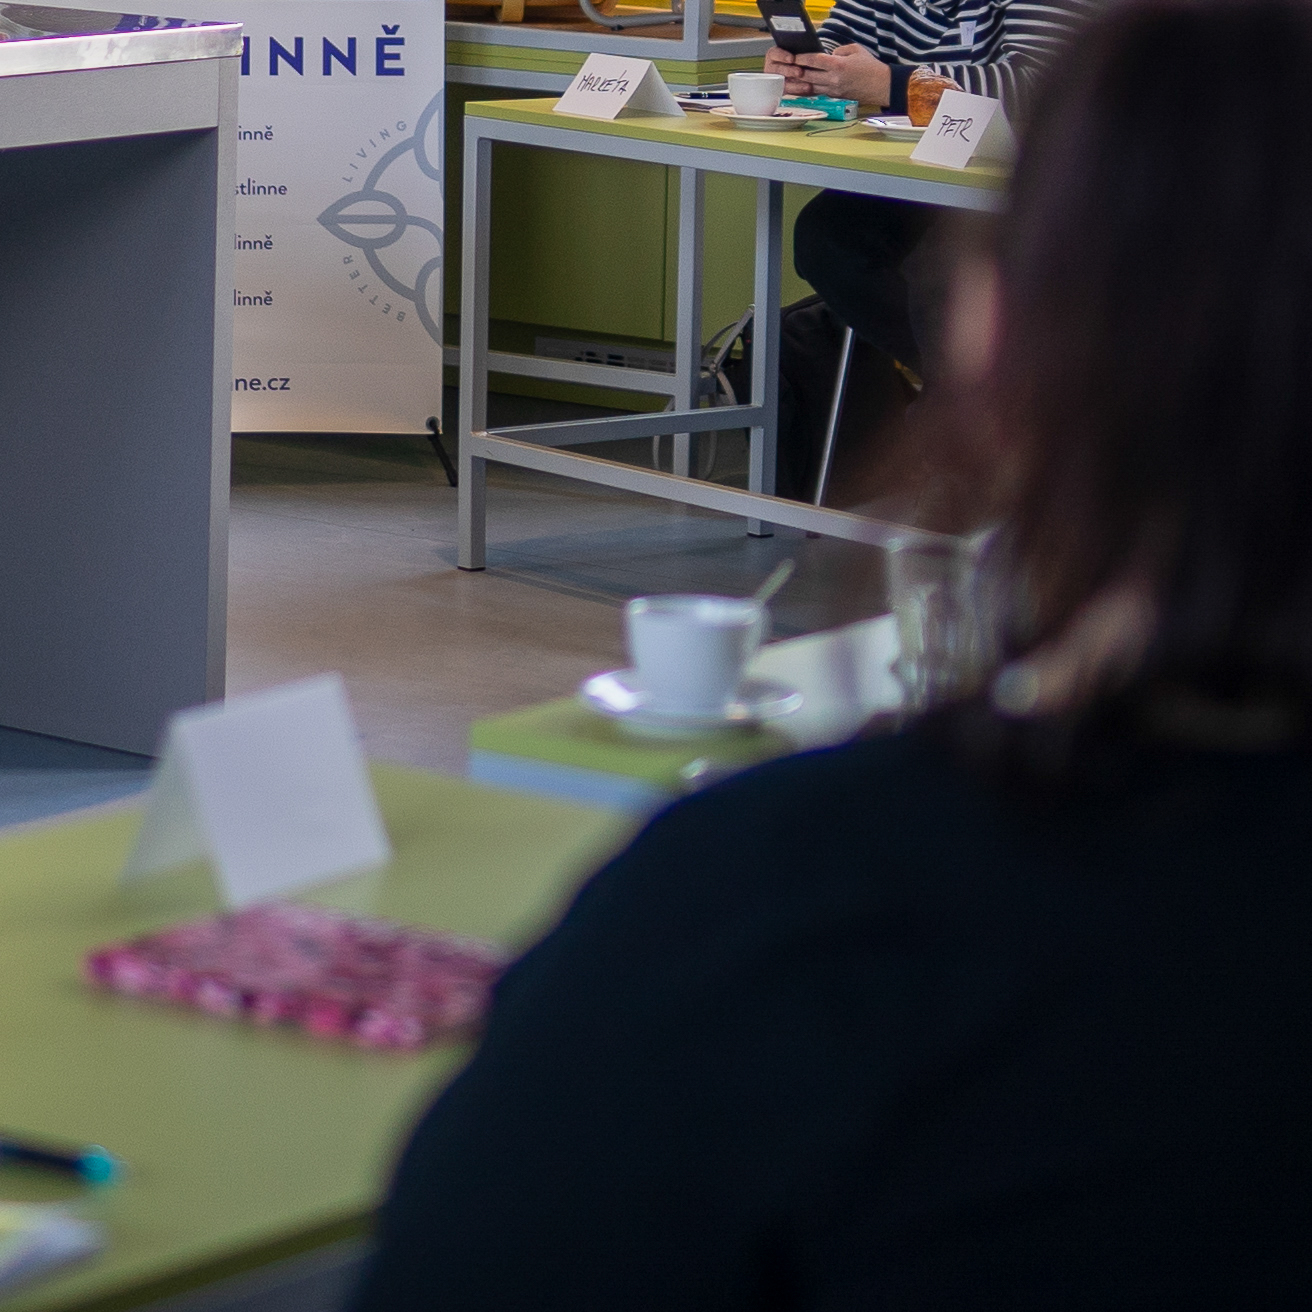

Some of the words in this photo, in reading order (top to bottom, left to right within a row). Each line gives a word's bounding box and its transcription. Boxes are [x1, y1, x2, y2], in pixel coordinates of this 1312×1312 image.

[241, 24, 405, 76] INNĚ
[238, 125, 274, 141] inně
[936, 115, 973, 142] PETR
[342, 120, 407, 183] LIVING
[235, 177, 288, 196] tlinne
[234, 233, 274, 250] linně
[233, 288, 274, 306] linně
[342, 255, 406, 322] BETTER
[235, 377, 291, 391] ne.cz
